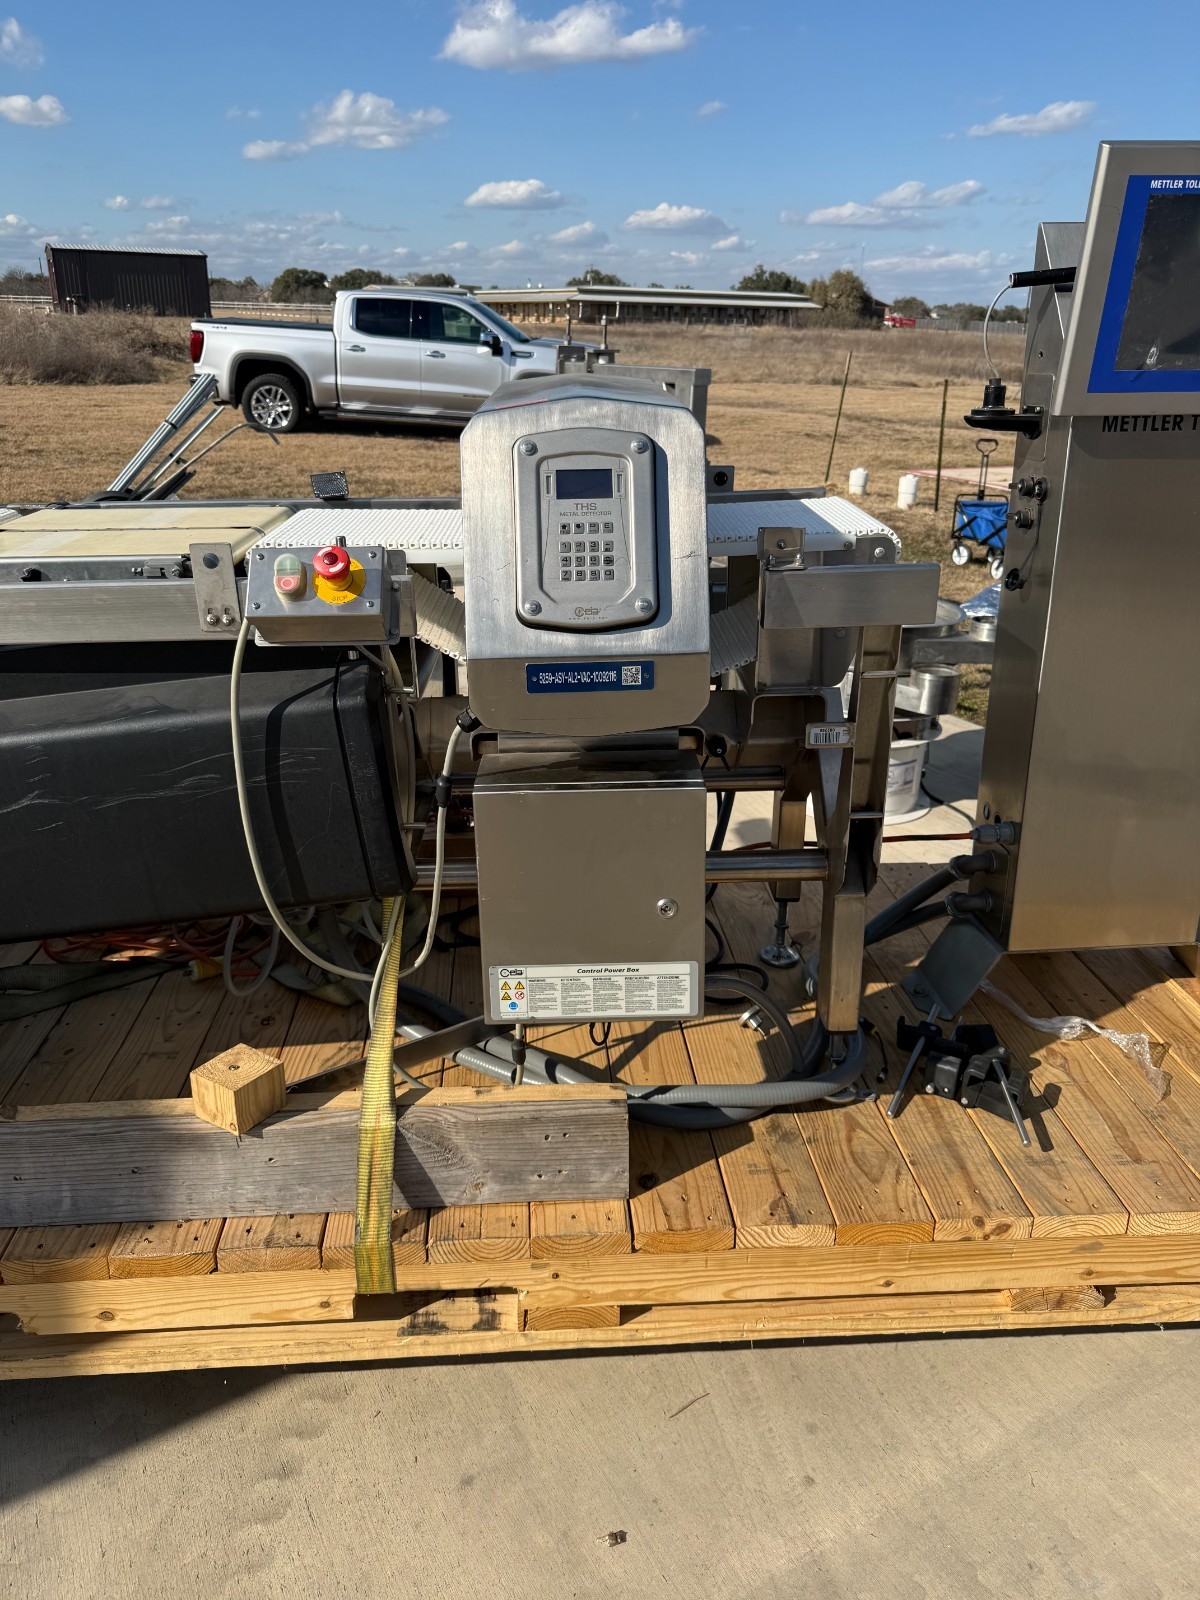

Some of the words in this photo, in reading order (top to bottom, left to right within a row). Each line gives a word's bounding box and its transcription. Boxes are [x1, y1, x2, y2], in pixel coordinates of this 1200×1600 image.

[1150, 179, 1184, 189] METTLER
[1185, 179, 1200, 188] TOL
[1102, 415, 1184, 433] METTLER
[573, 502, 597, 511] THS
[604, 967, 626, 975] Power
